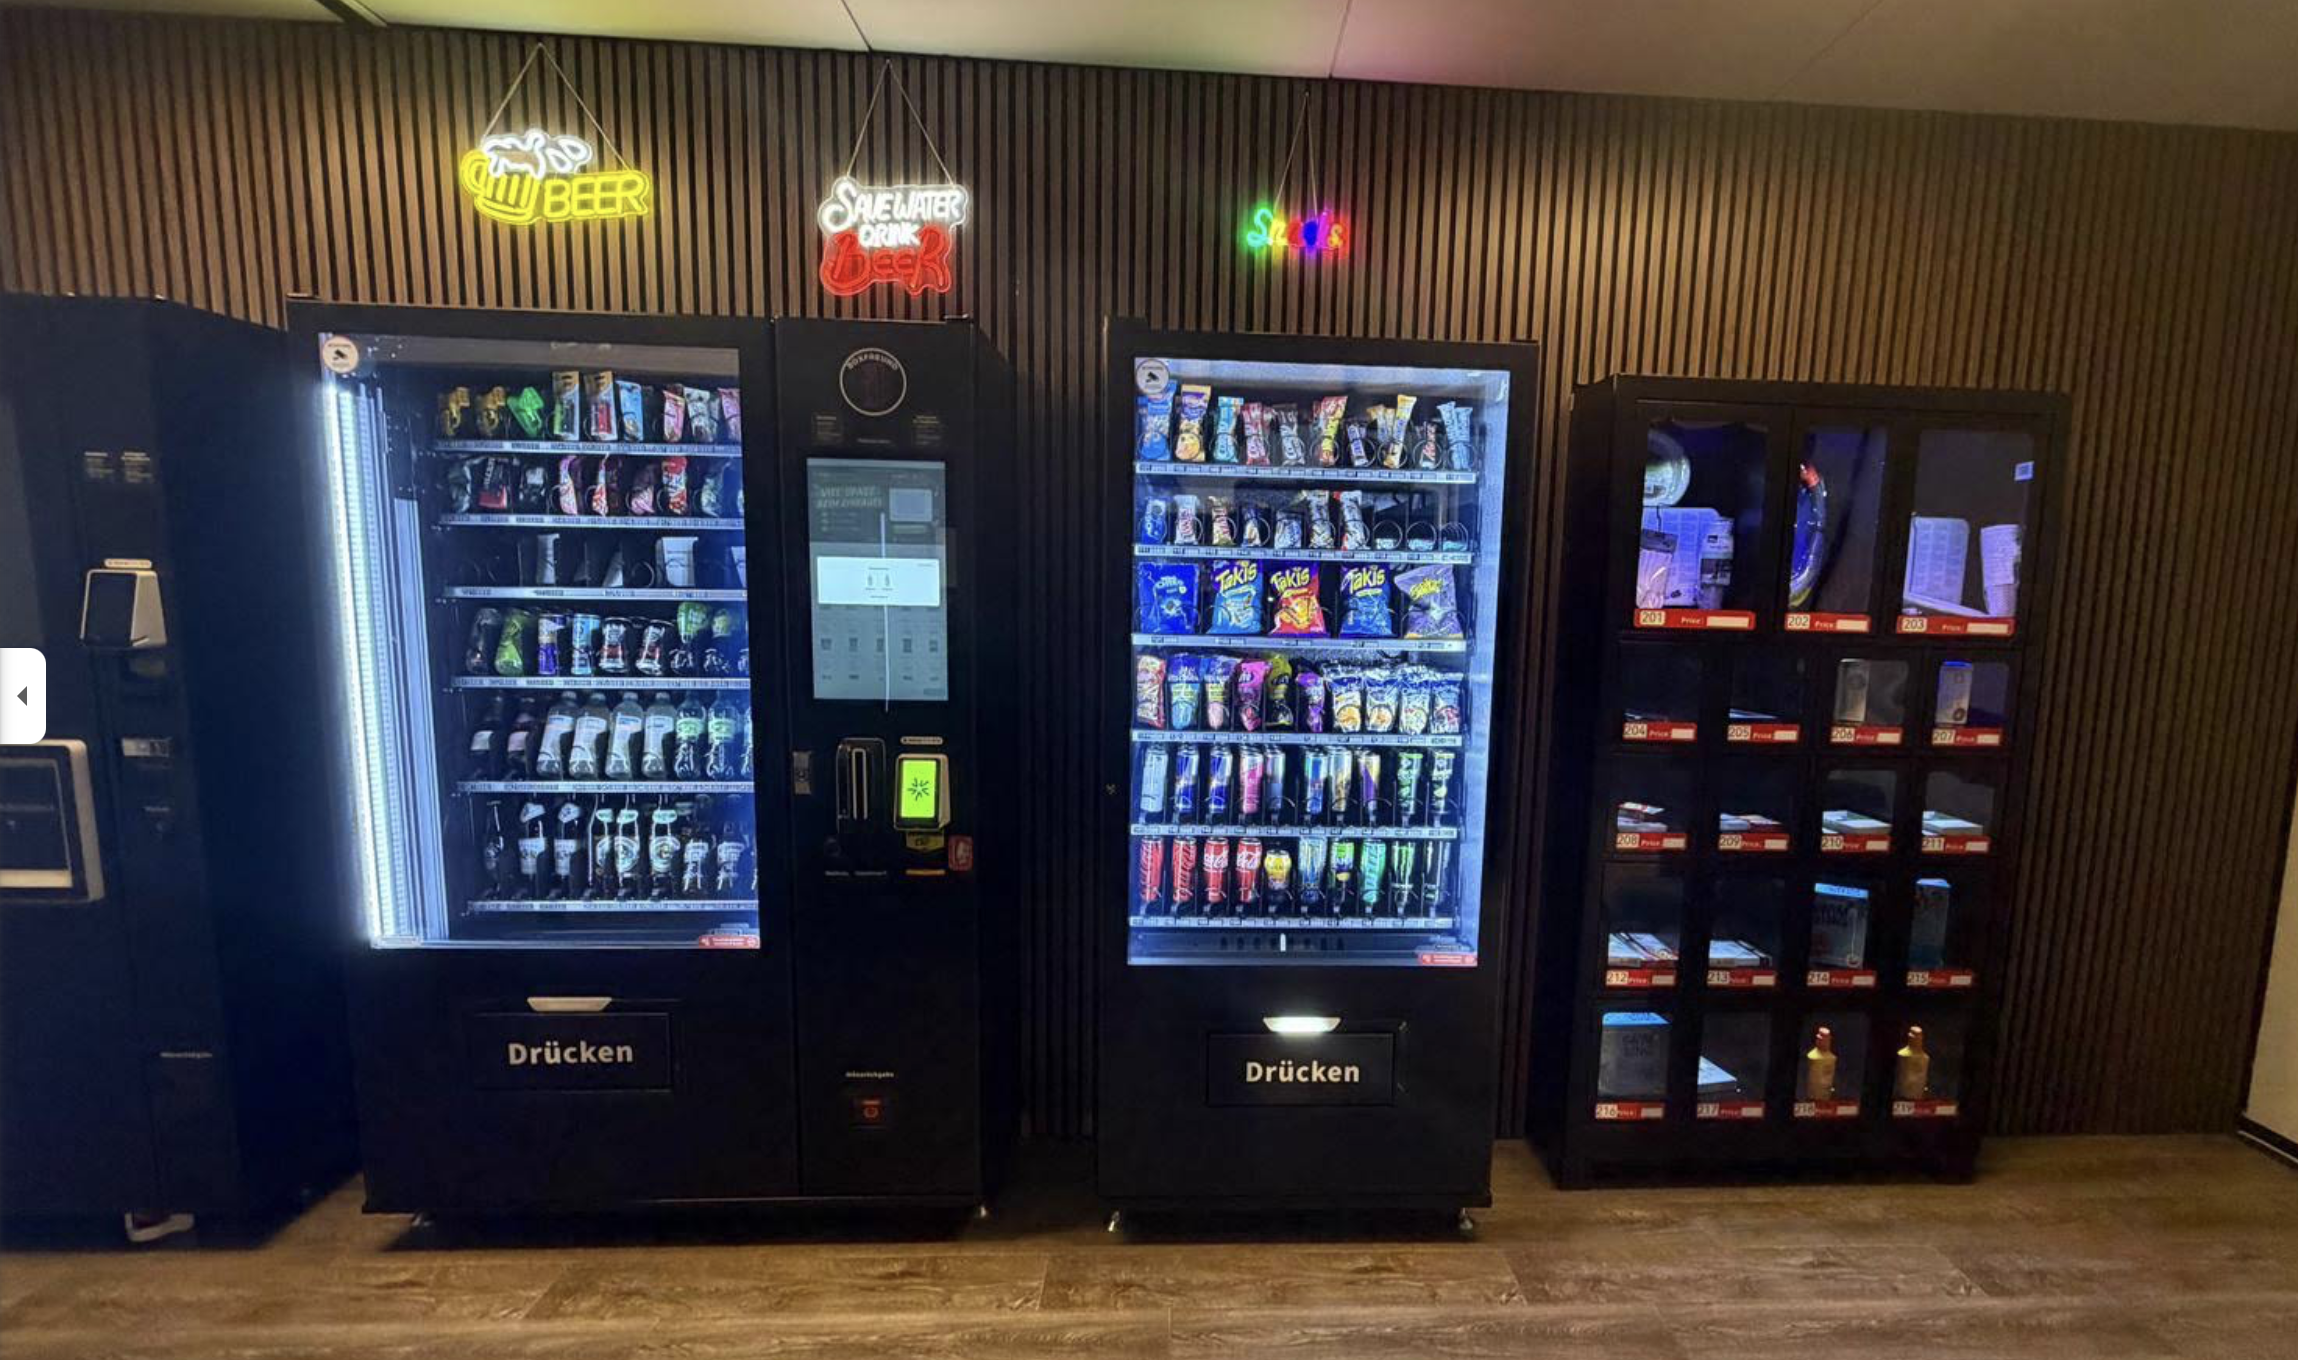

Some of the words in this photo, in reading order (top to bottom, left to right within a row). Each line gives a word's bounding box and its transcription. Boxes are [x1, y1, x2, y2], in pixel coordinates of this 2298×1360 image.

[543, 174, 644, 218] BEER
[822, 182, 893, 233] SAVE
[894, 189, 961, 221] WATER
[1247, 208, 1343, 248] Sns
[858, 221, 921, 248] DRINK
[1216, 562, 1257, 591] Takis
[1270, 566, 1310, 591] Takis
[1347, 565, 1385, 593] Takis
[1642, 612, 1662, 623] 201
[1788, 616, 1809, 627] 202
[1904, 619, 1924, 630] 203
[1624, 724, 1646, 736] 204
[1729, 726, 1749, 738] 205
[1934, 730, 1953, 741] 207
[1618, 835, 1638, 846] 208
[1720, 836, 1739, 847] 209
[1822, 836, 1842, 847] 210
[1607, 971, 1627, 982] 212
[508, 1041, 633, 1065] Drücken
[1246, 1060, 1360, 1083] Drücken
